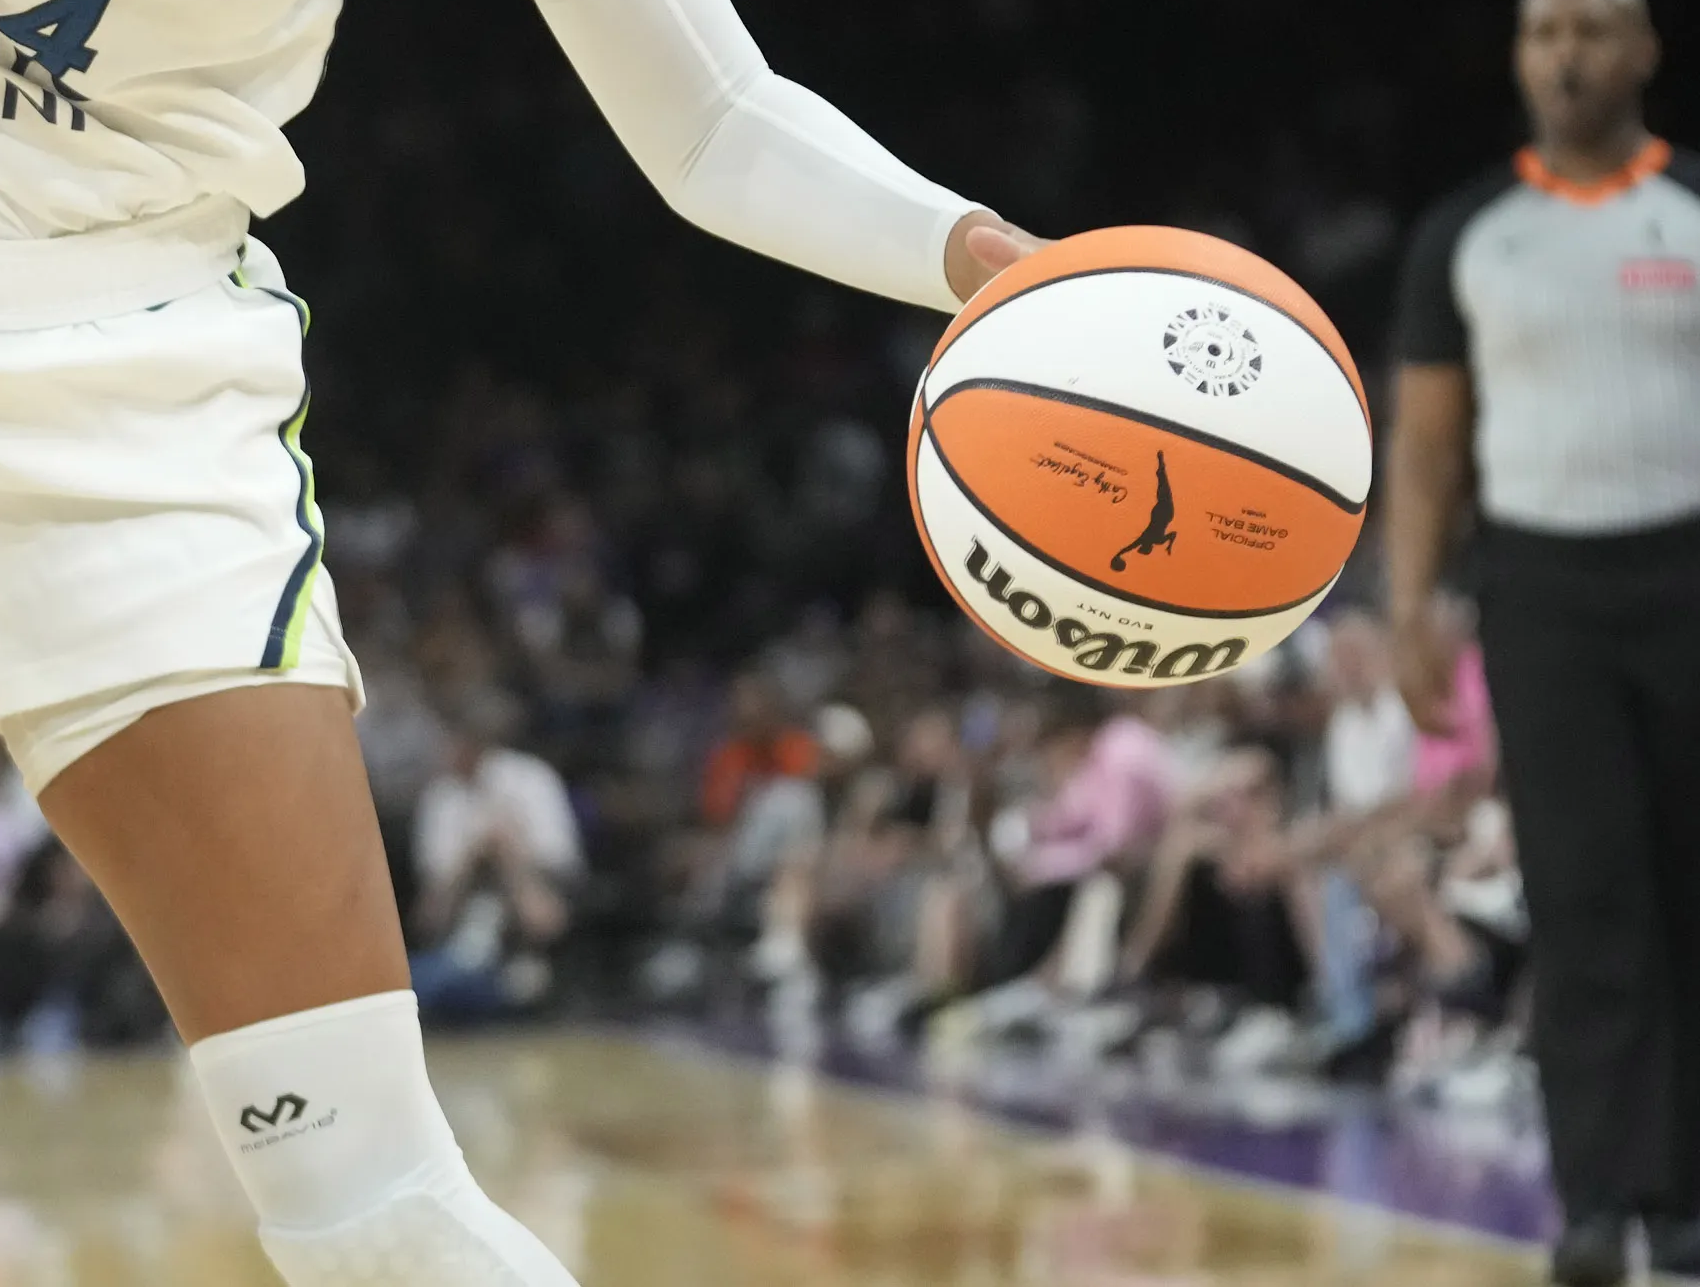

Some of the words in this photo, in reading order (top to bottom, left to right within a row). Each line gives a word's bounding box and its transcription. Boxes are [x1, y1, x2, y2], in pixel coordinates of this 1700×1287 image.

[1204, 510, 1246, 531] BALL
[1246, 521, 1289, 540] GAME
[1211, 527, 1276, 551] OFFICIAL
[964, 534, 1250, 679] Wilson
[1076, 602, 1112, 621] NXT
[1117, 617, 1154, 632] EVO
